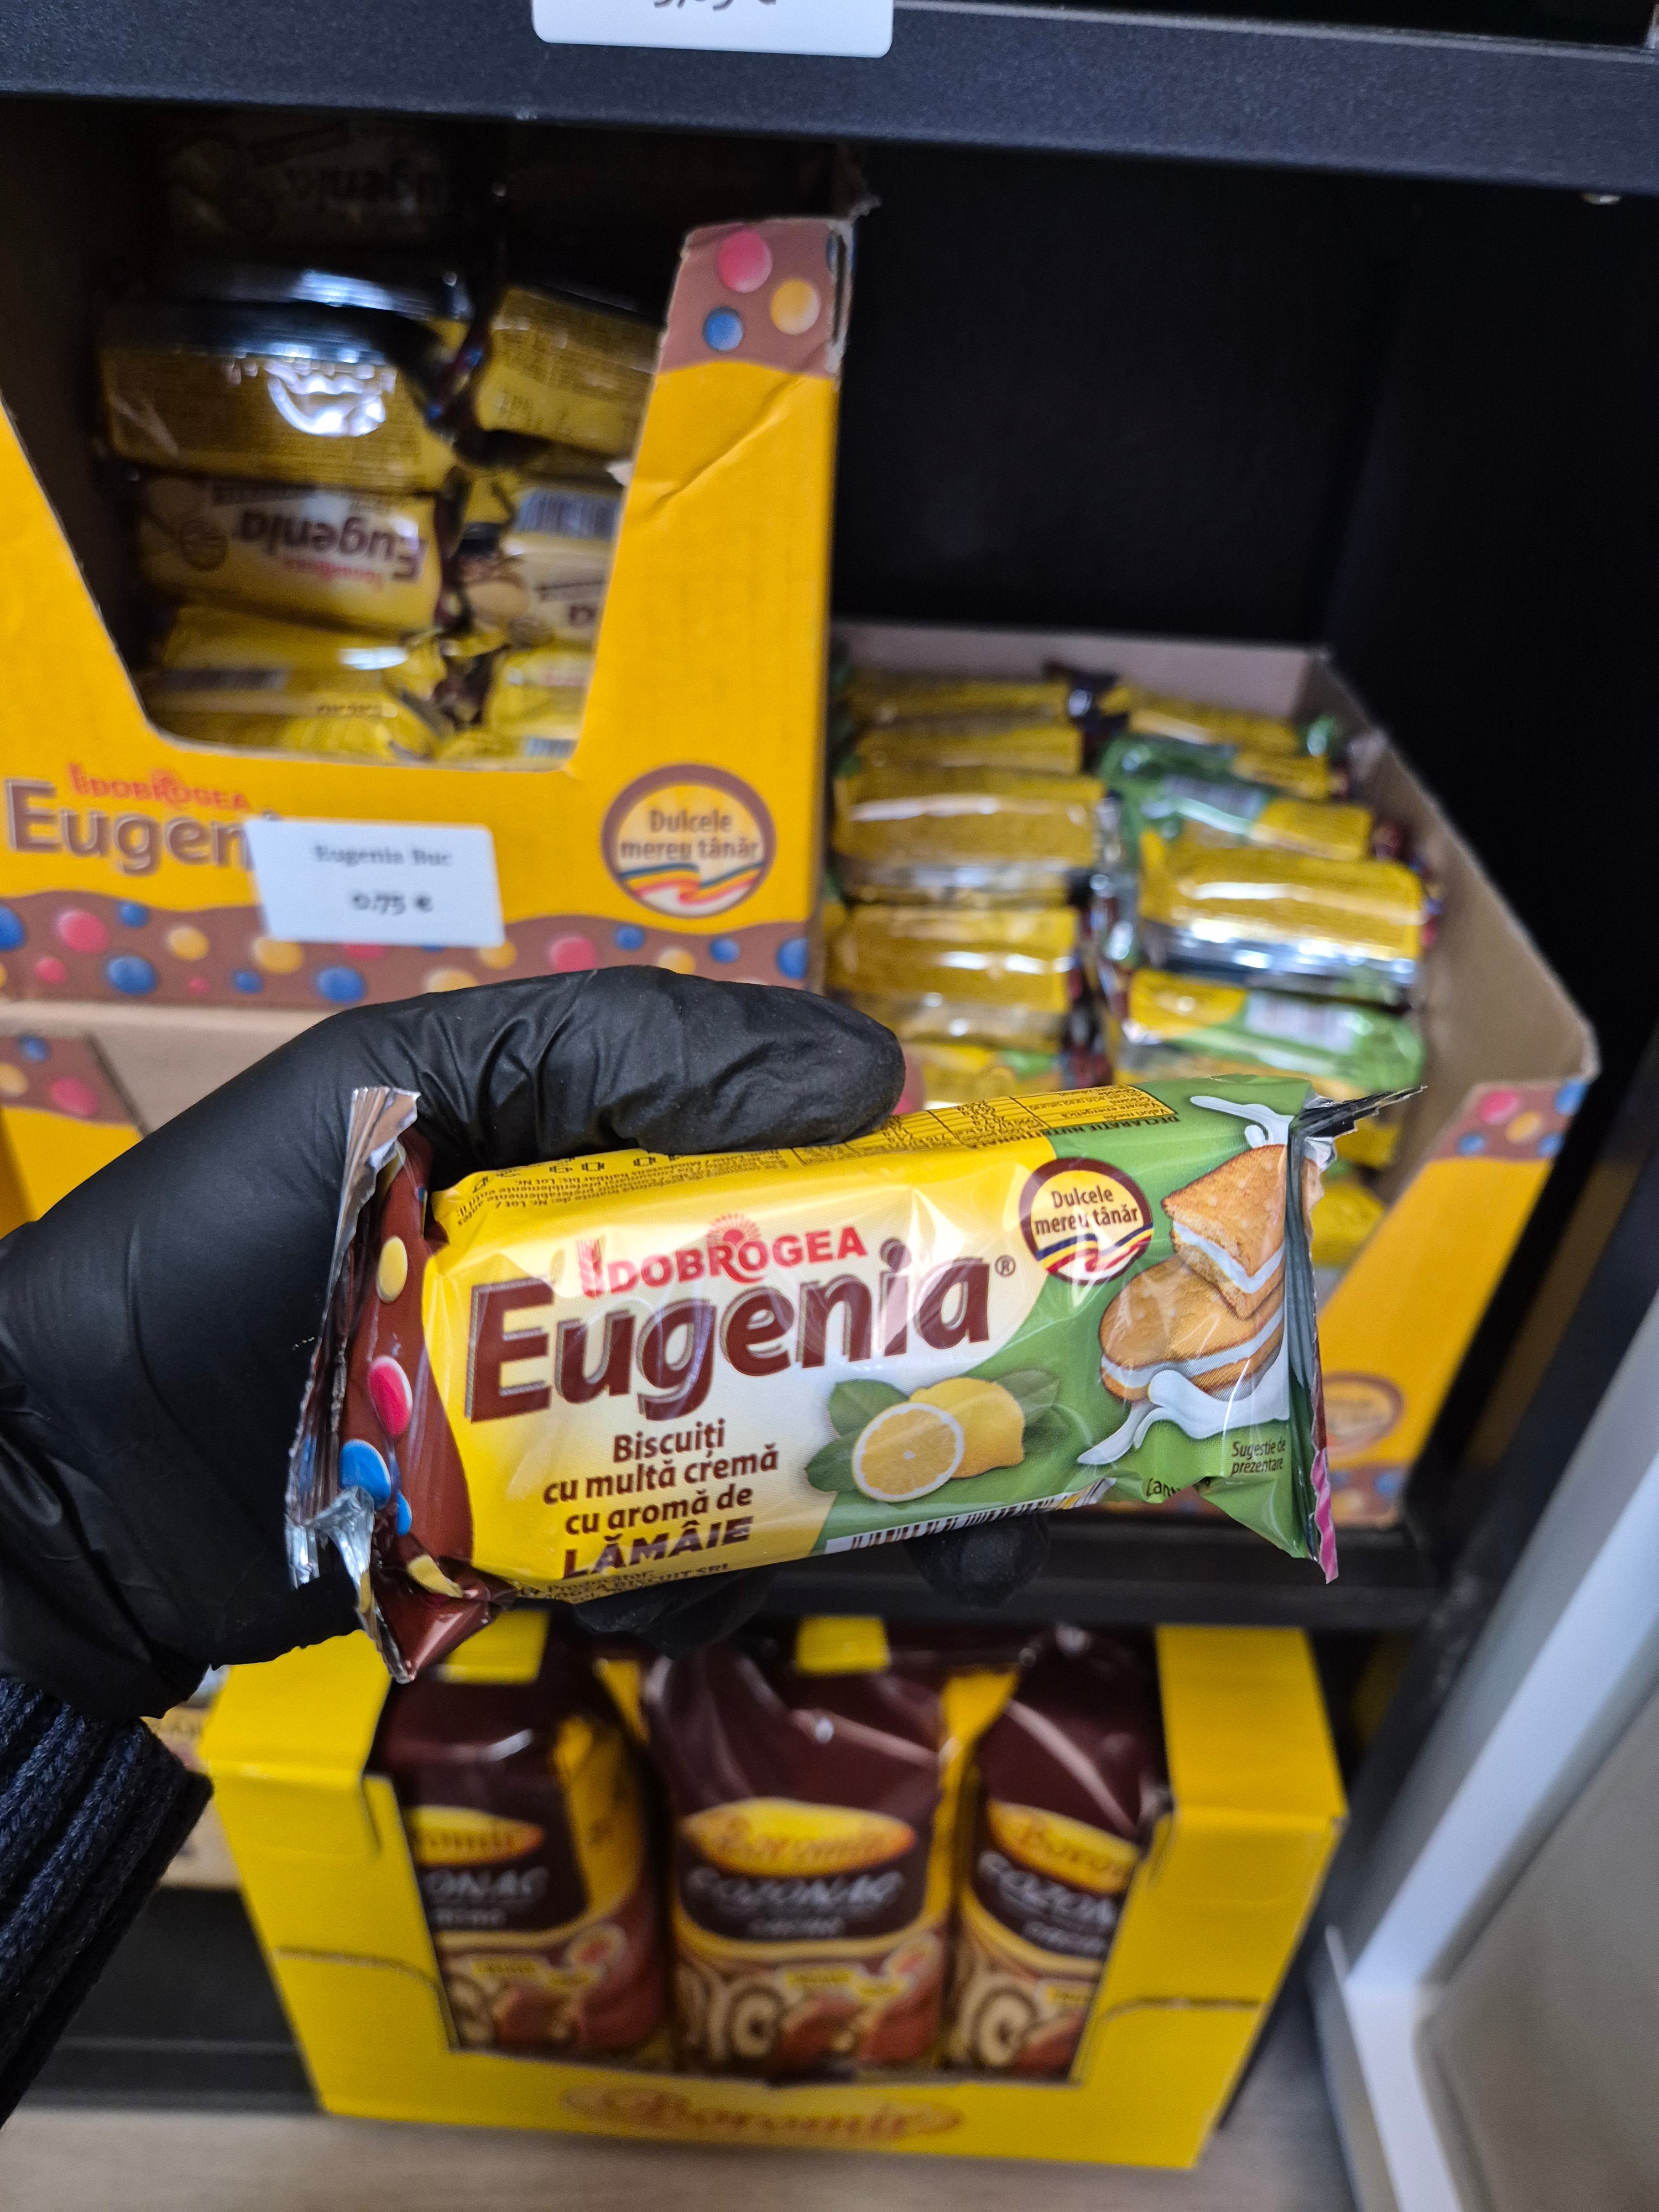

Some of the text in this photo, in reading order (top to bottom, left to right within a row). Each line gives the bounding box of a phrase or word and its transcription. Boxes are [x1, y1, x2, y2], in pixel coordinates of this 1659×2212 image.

[6, 777, 255, 877] Eugen
[649, 808, 732, 832] Dulcele
[620, 835, 759, 860] mereu tânăr
[1034, 1203, 1138, 1235] mereu tânăr
[1051, 1185, 1114, 1208] Dulcele
[607, 1226, 867, 1295] DOBROGEA
[465, 1238, 990, 1422] Eugenia
[613, 1418, 726, 1464] Biscuiți
[1231, 1437, 1286, 1460] Sugestie de
[542, 1442, 780, 1505] cu multă cremă
[1230, 1457, 1284, 1475] prezentare
[565, 1483, 754, 1535] cu aromă de
[562, 1515, 754, 1580] LĂMÂIE
